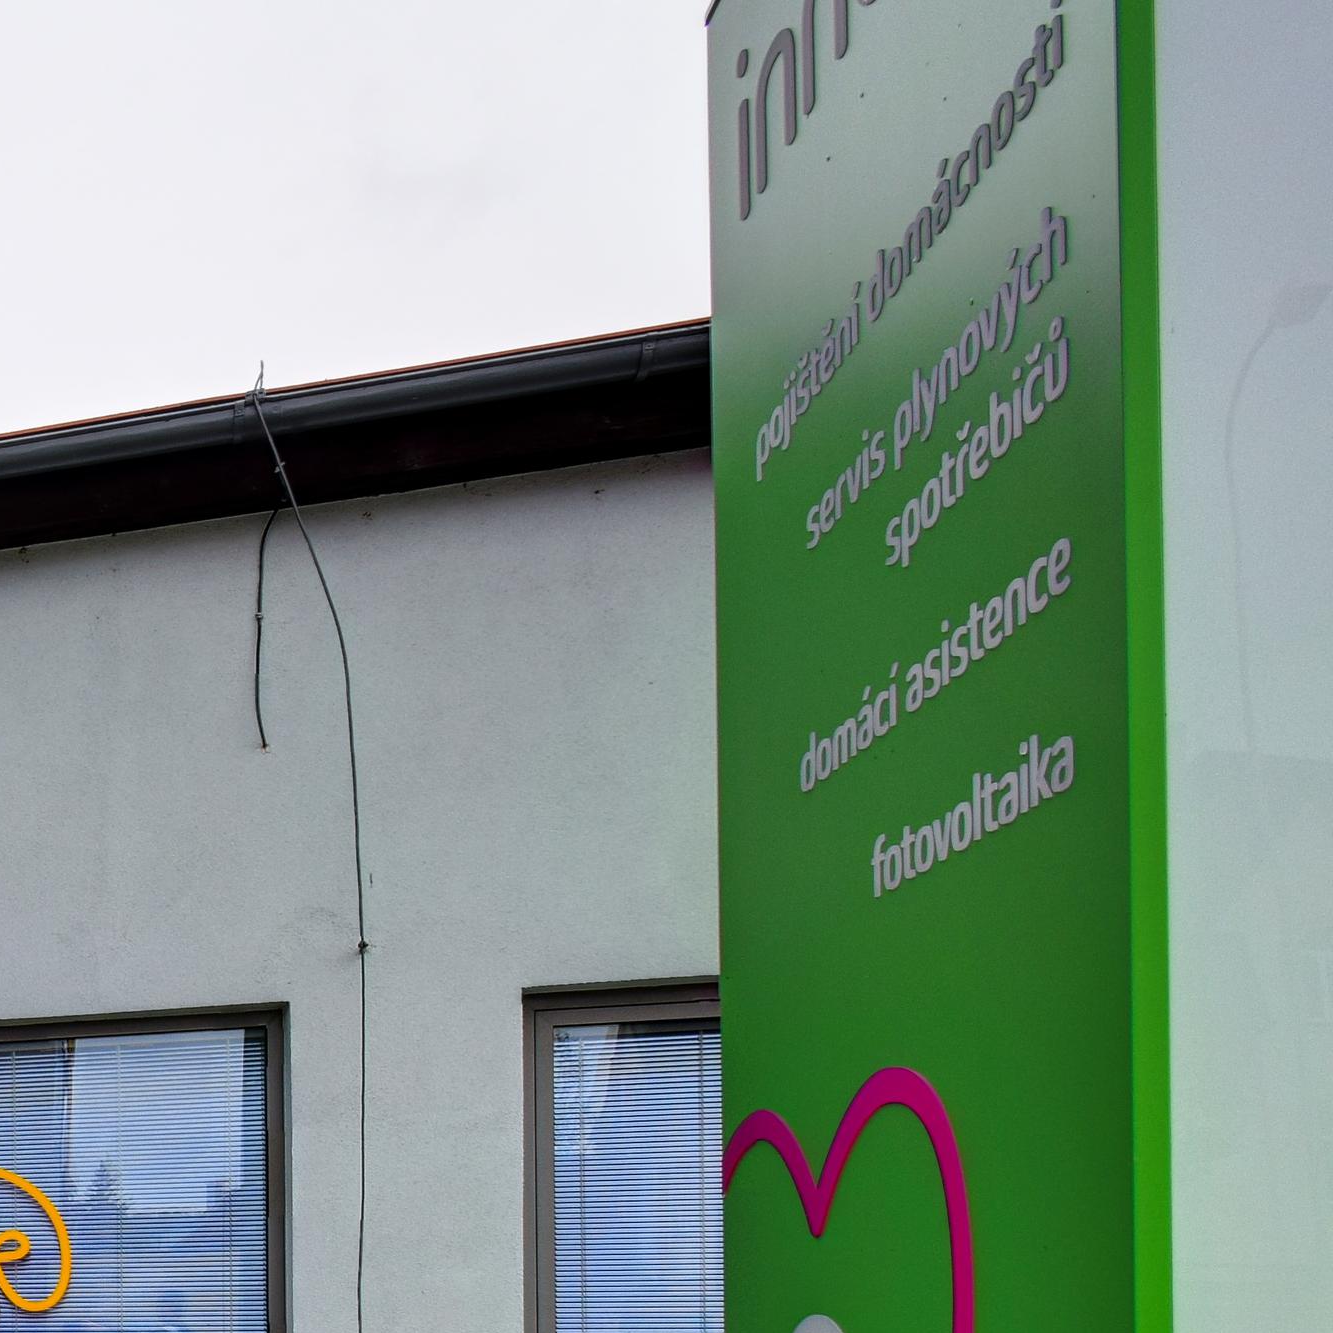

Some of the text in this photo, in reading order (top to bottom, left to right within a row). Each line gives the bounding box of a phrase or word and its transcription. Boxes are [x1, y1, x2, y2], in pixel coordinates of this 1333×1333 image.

[736, 0, 876, 221] inn
[755, 0, 1065, 482] pojištění domácnosti
[806, 206, 1068, 549] servis plynových
[885, 315, 1069, 568] spotřebičů
[799, 537, 1072, 793] domácí asistence
[870, 734, 1075, 898] fotovoltaika
